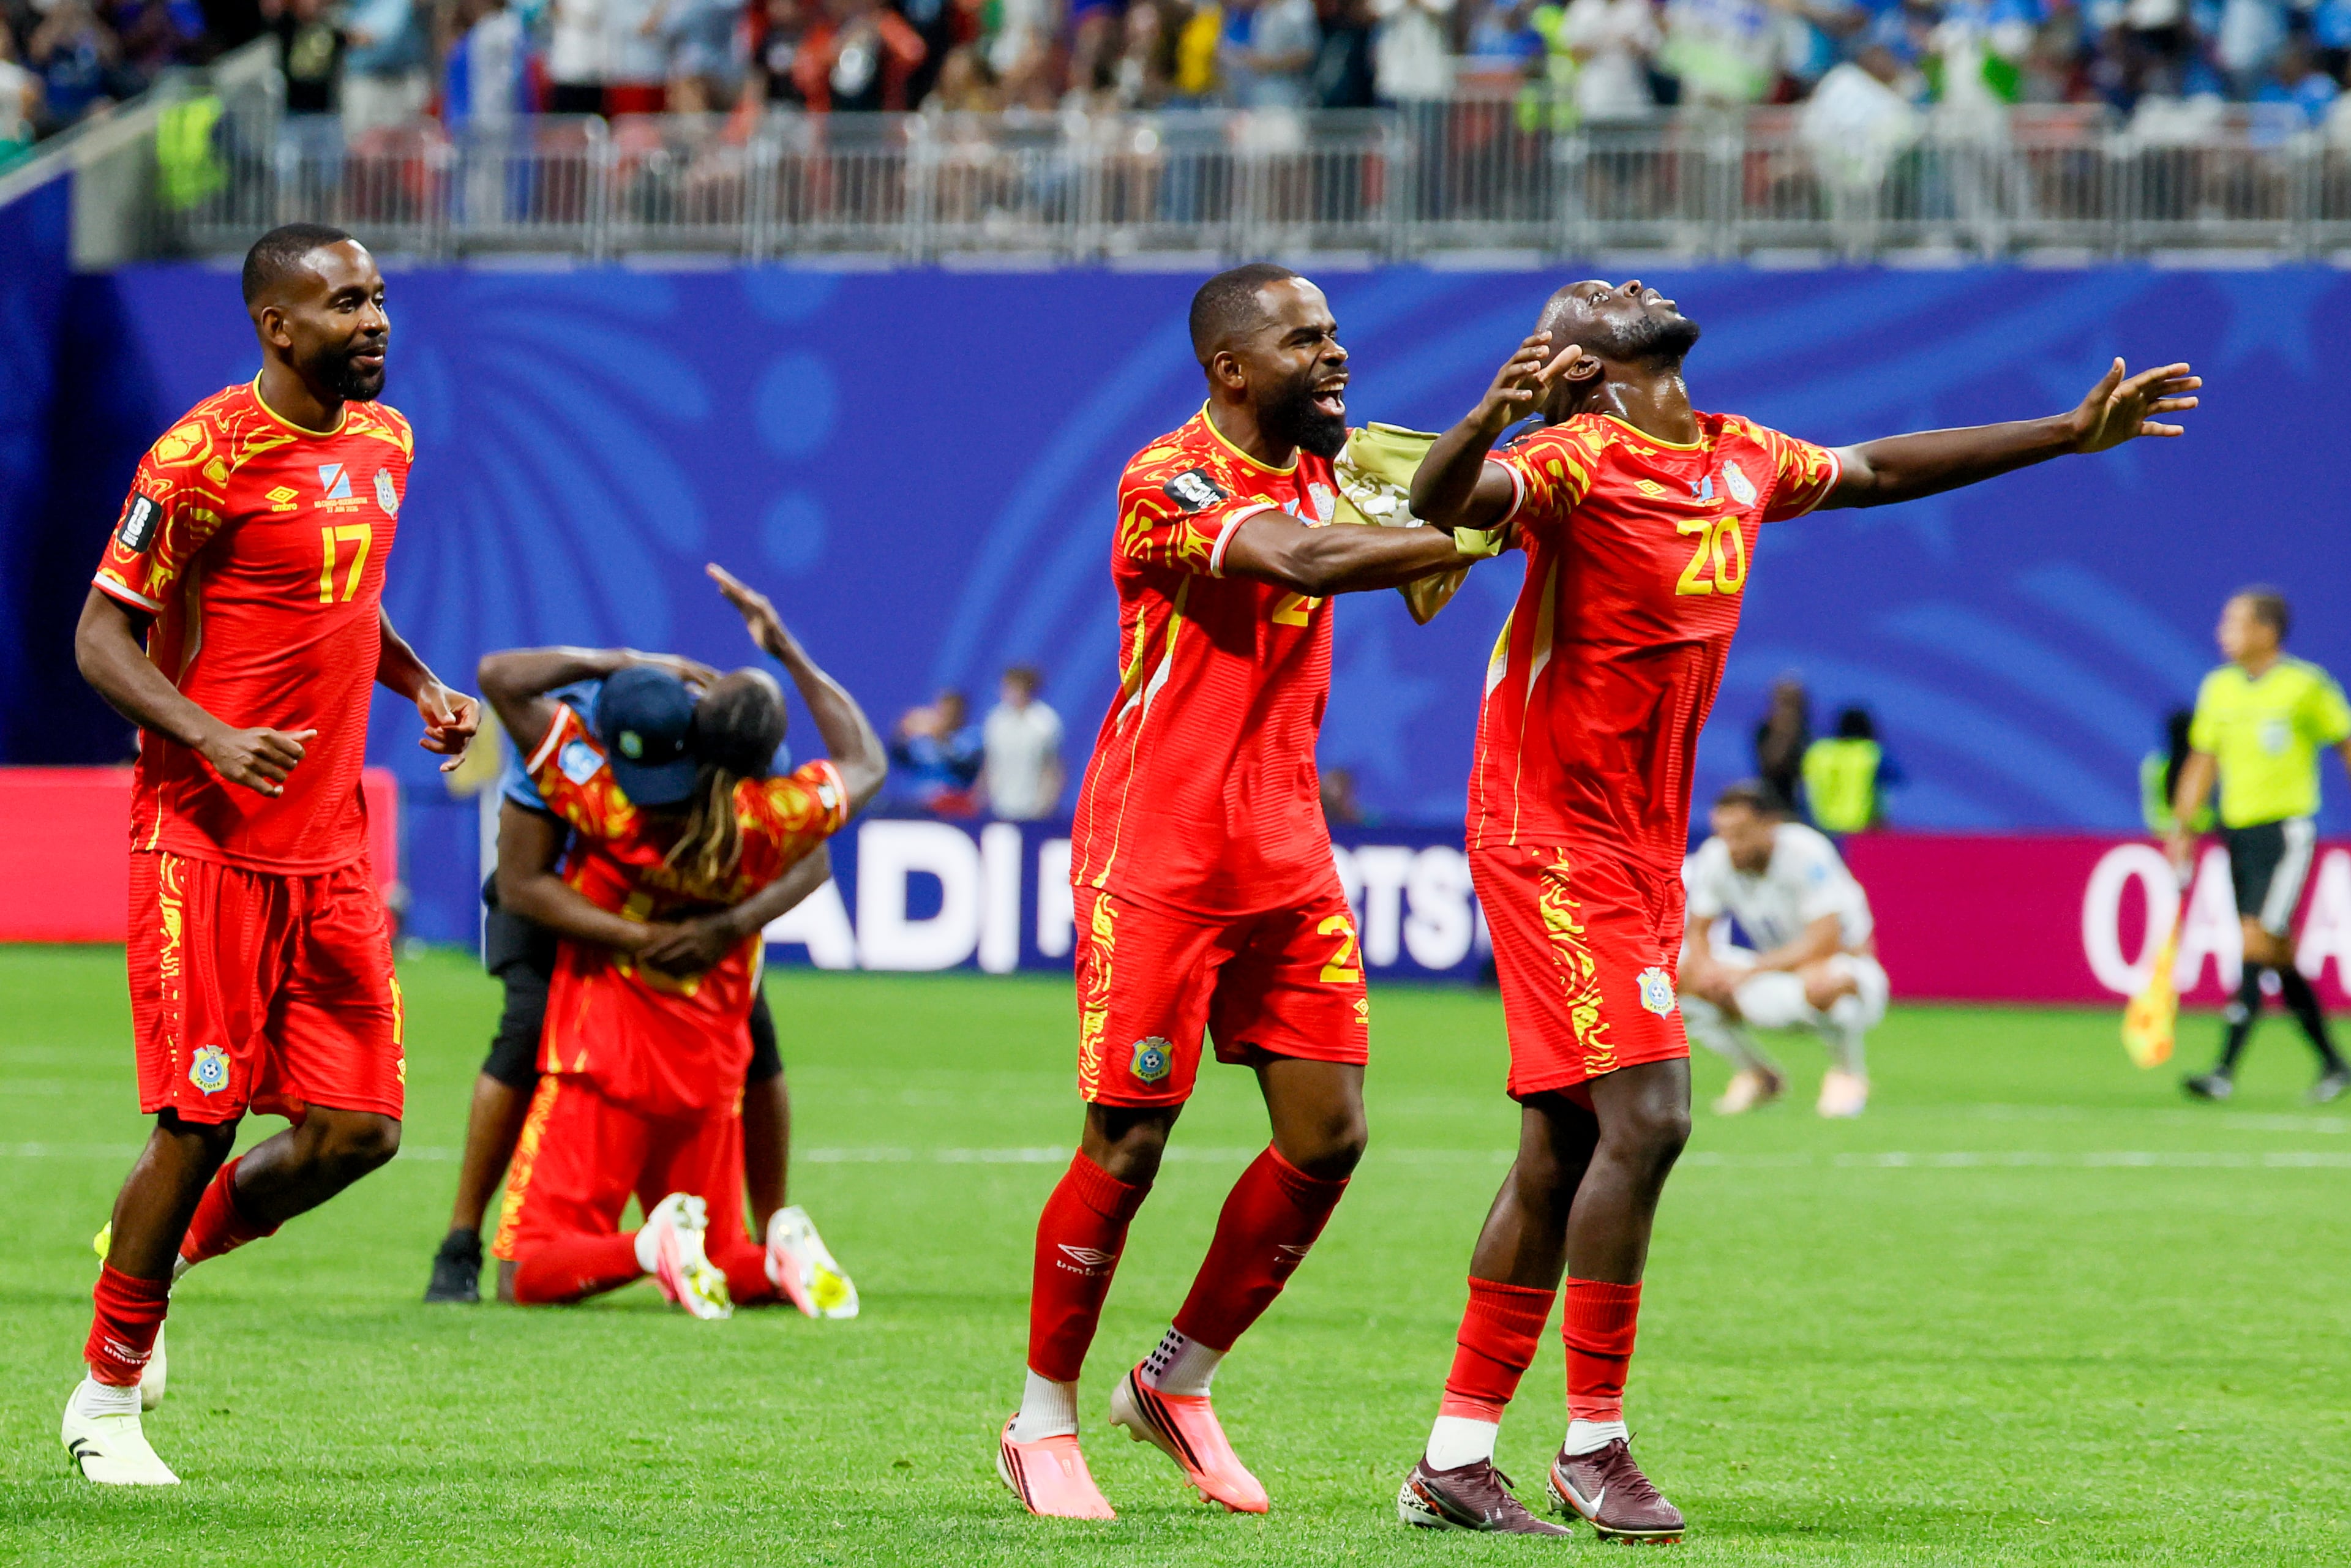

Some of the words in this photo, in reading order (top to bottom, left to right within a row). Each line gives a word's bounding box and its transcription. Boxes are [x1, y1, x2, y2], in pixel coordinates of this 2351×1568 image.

[271, 502, 298, 512] umbro
[319, 523, 372, 604] 17
[1675, 516, 1746, 596] 20
